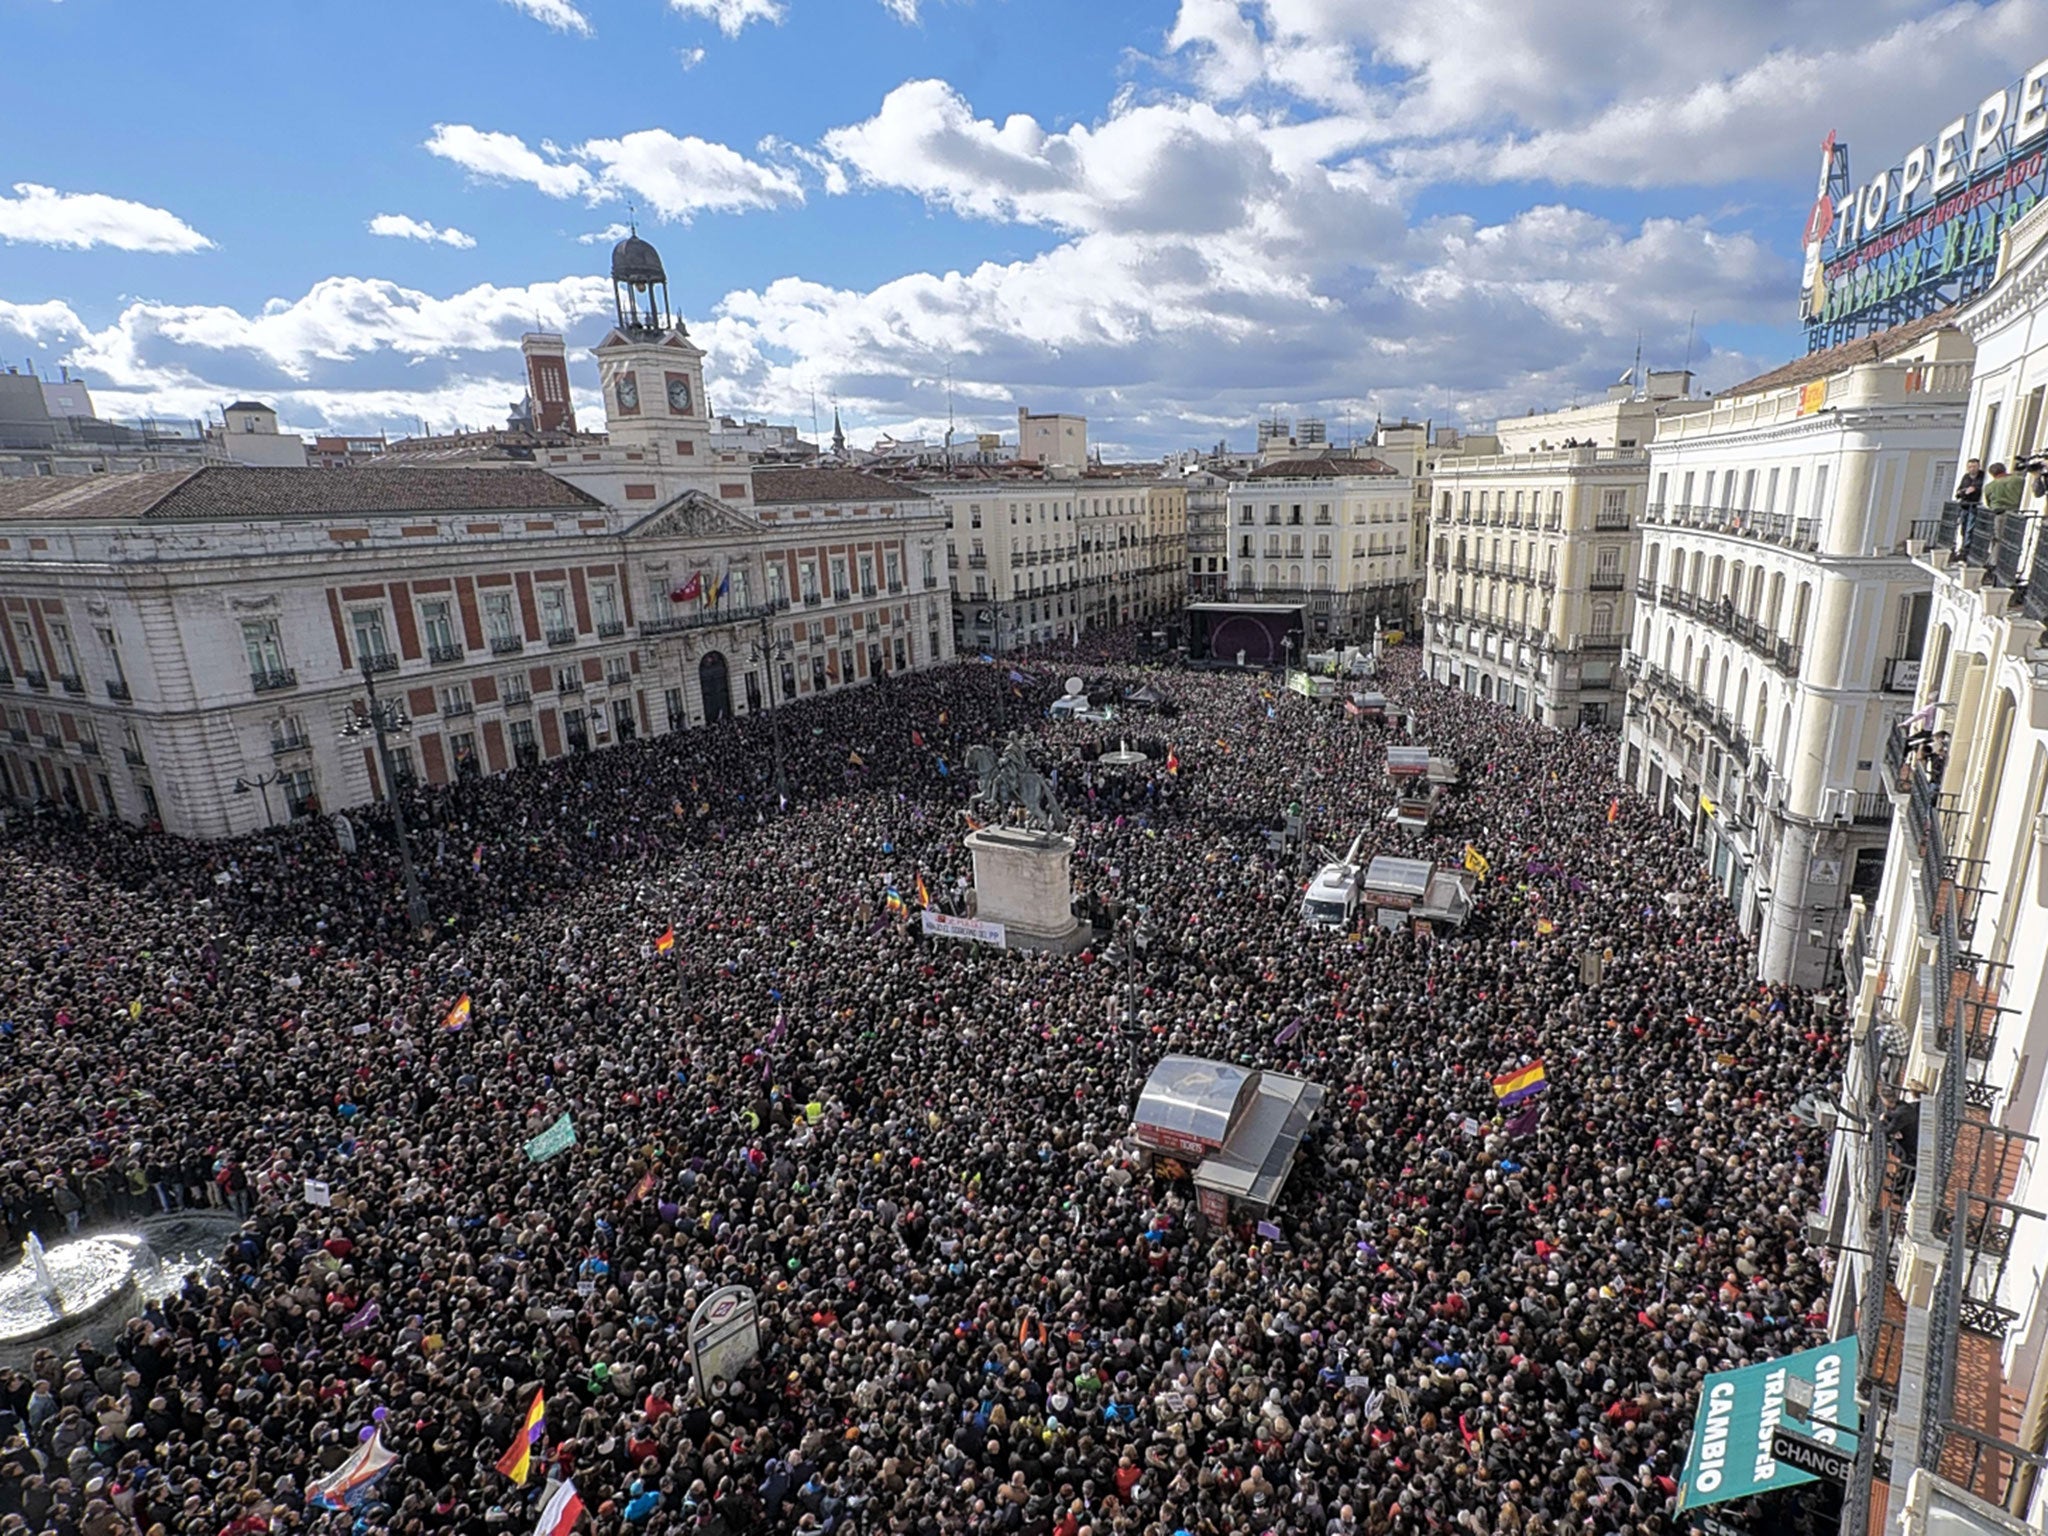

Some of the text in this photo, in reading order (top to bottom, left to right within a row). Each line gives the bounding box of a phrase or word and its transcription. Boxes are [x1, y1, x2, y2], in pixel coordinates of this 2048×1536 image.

[1836, 56, 2048, 249] TIO PEPE
[1926, 152, 2043, 231] EMBOTELLADO
[1696, 1382, 1735, 1492] CAMBIO
[1753, 1367, 1786, 1483] TRANSFER
[1811, 1354, 1841, 1446] CHANG
[1774, 1438, 1850, 1481] CHANGE
